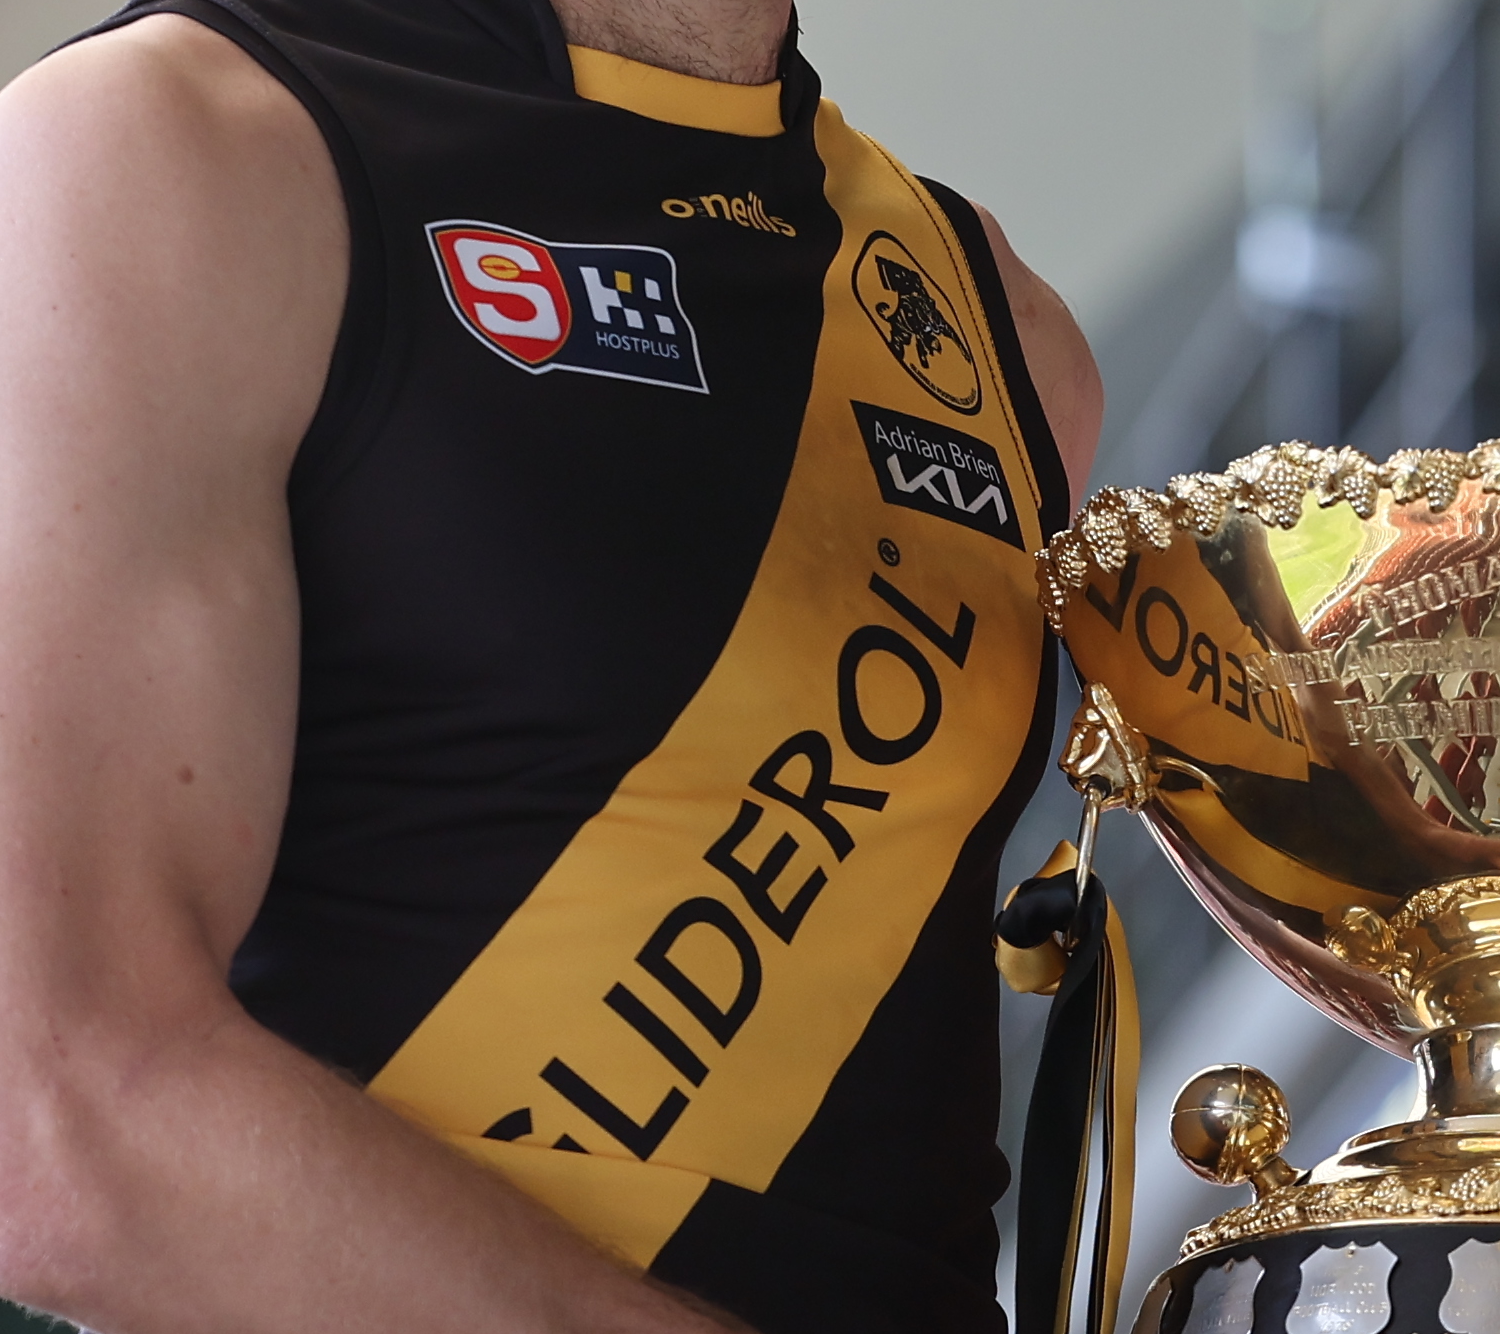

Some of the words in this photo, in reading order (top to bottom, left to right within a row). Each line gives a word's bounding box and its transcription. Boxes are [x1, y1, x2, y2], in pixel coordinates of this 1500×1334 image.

[595, 330, 680, 360] HOSTPLUS
[874, 420, 948, 464] Adrian
[948, 441, 1001, 485] Brien
[480, 571, 976, 1162] LIDEROL
